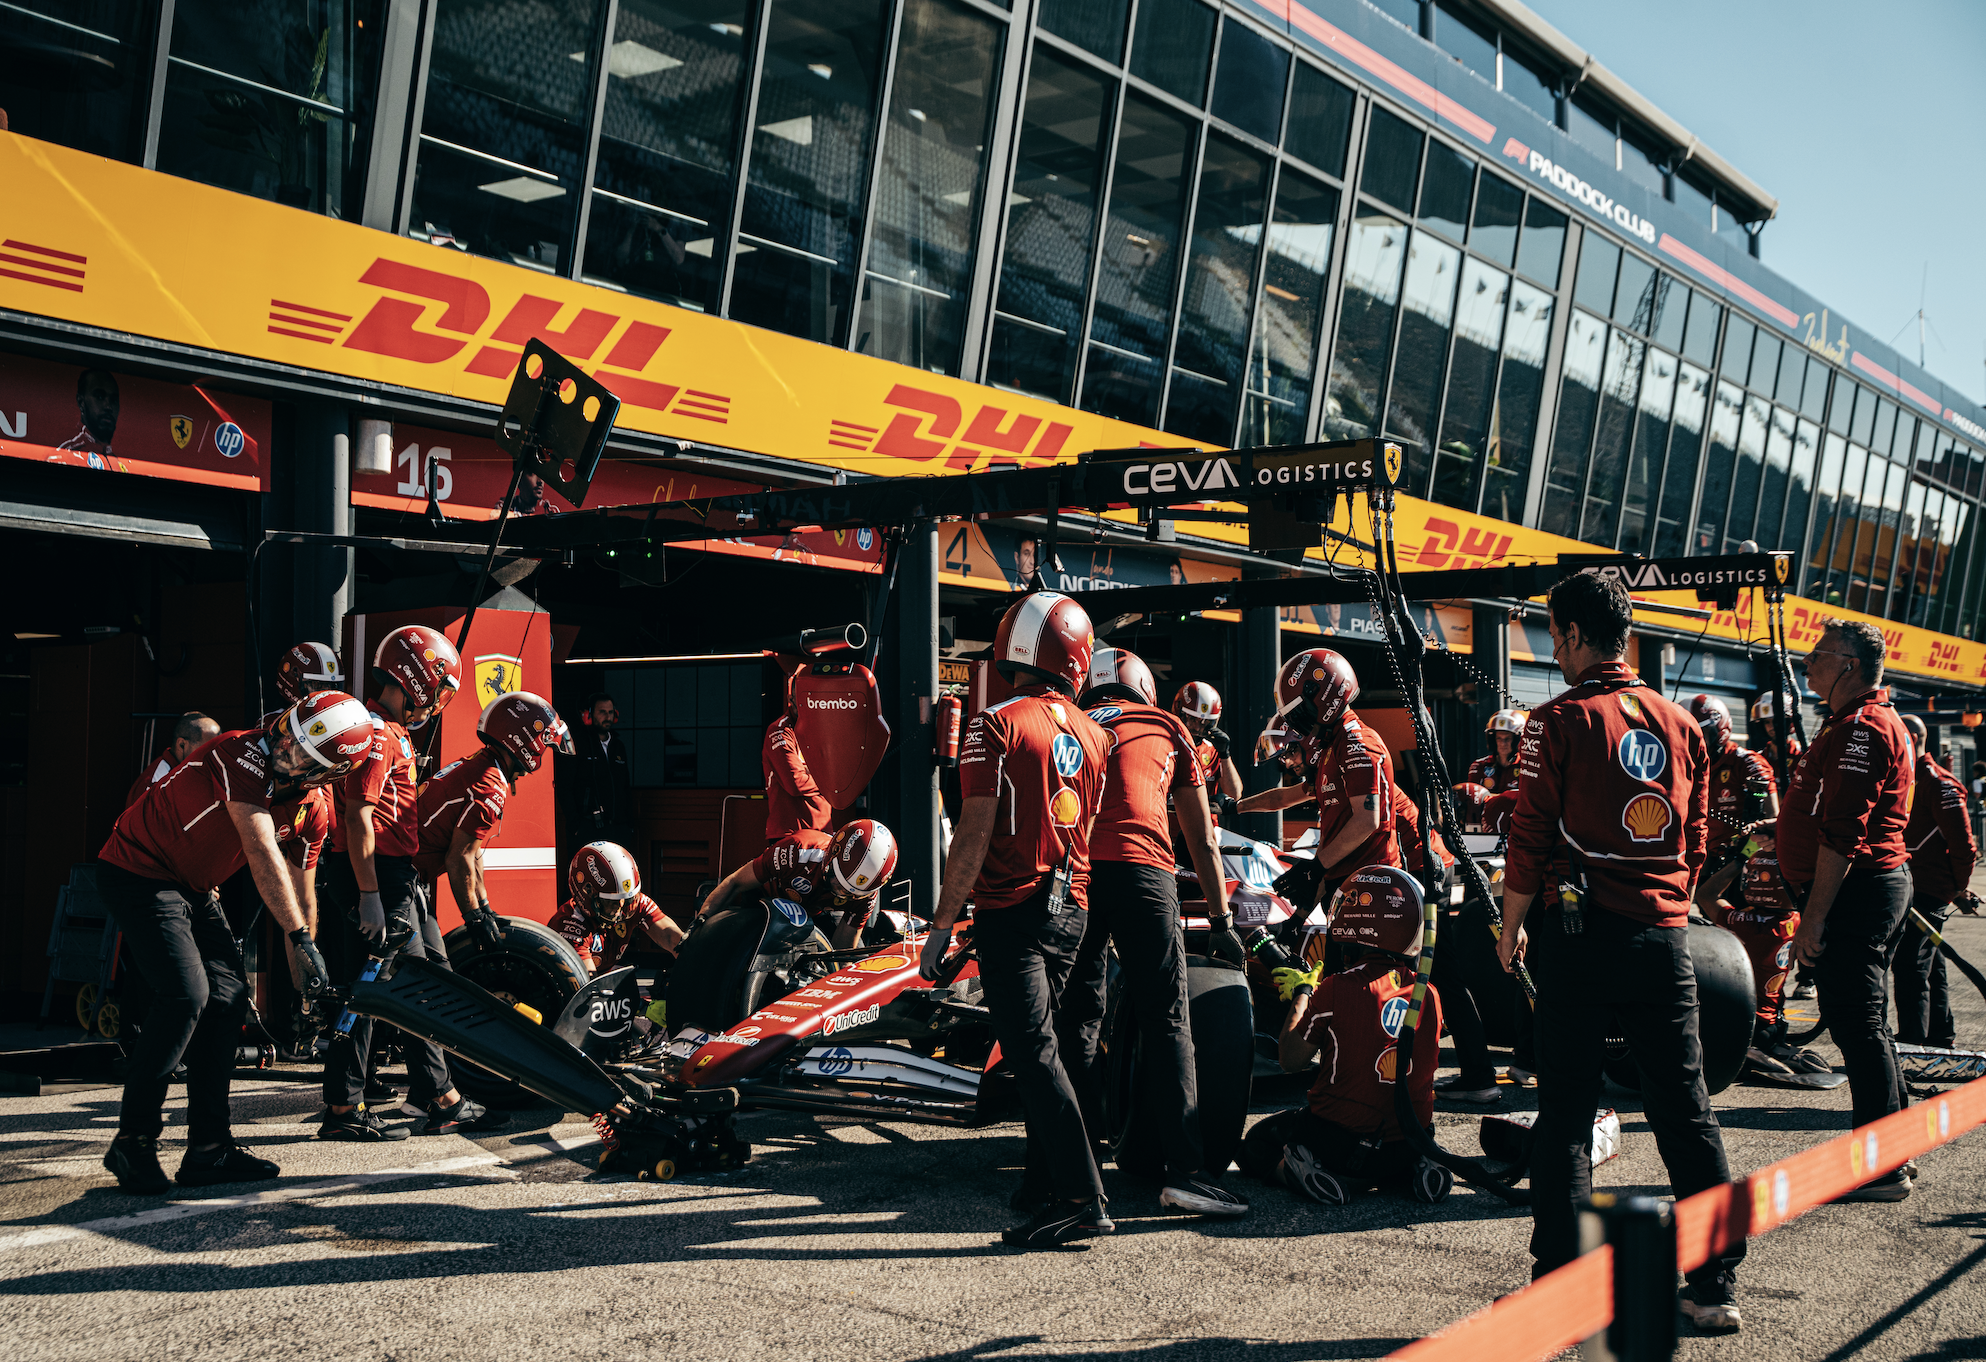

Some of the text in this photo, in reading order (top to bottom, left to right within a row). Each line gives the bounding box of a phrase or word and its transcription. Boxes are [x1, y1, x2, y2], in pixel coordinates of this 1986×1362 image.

[1530, 149, 1614, 219] PADDOCK
[1614, 204, 1656, 244] CLUB
[342, 257, 679, 411] DHL
[872, 384, 1074, 473] DHL
[218, 423, 242, 457] hp
[397, 442, 453, 501] 16
[1251, 460, 1373, 485] OGISTICS
[858, 528, 872, 549] hp
[1415, 517, 1514, 570] DHL
[946, 527, 971, 578] 4
[1671, 569, 1767, 586] LOGISTICS
[1927, 641, 1961, 672] DHL
[939, 664, 970, 681] DEWA
[807, 697, 858, 710] brembo
[1087, 707, 1120, 724] hp
[1527, 719, 1545, 730] aws
[346, 735, 372, 755] UniCredit
[1852, 730, 1870, 738] aws
[244, 750, 266, 767] ZCG
[1056, 733, 1079, 776] hp
[1626, 731, 1659, 780] hp
[1845, 743, 1870, 754] DXC
[236, 757, 265, 779] PIRELLI
[794, 877, 811, 894] hp
[1358, 874, 1391, 884] UniCredit
[775, 899, 805, 926] hp
[563, 925, 581, 935] ZCG
[830, 975, 863, 984] aws
[795, 988, 843, 1000] IBM
[591, 998, 631, 1023] aws
[835, 1002, 880, 1031] UniCredit
[821, 1047, 851, 1075] hp
